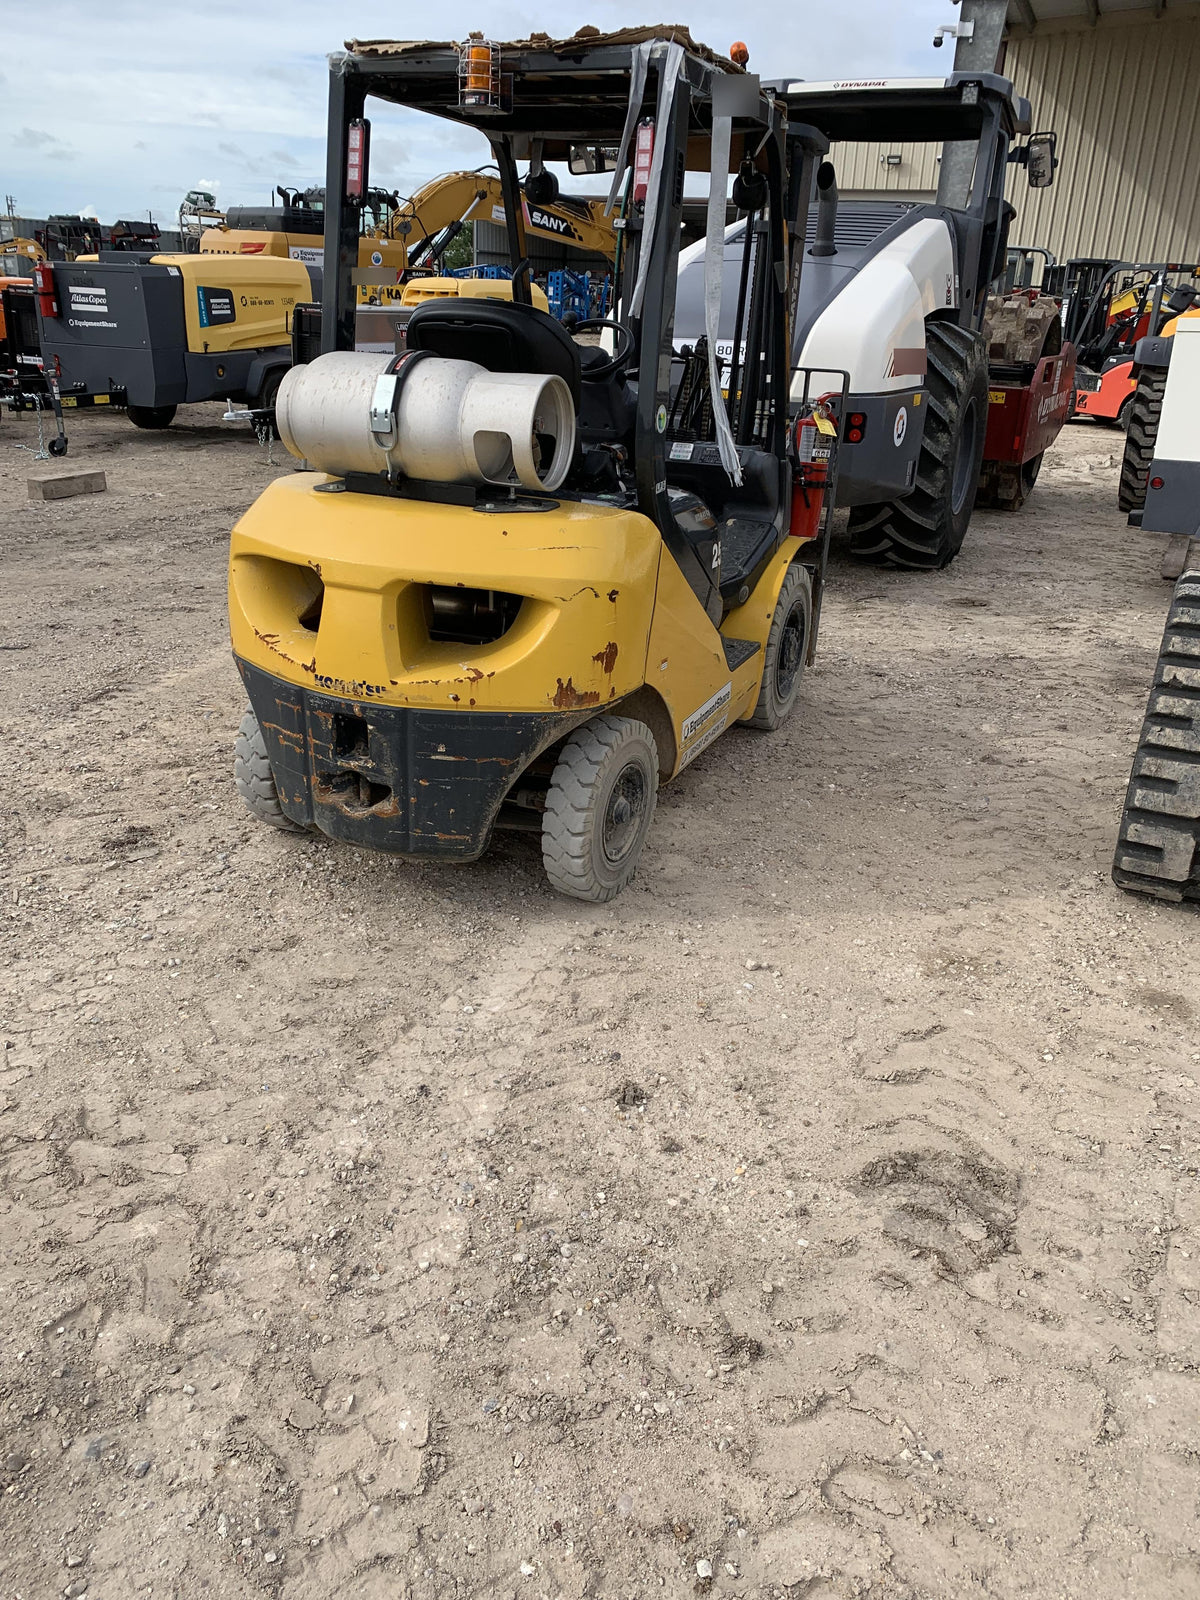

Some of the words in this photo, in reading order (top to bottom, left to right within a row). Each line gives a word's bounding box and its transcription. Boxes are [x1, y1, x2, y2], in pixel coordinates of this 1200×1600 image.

[532, 211, 568, 232] SANY
[71, 293, 89, 303] Atlas
[89, 295, 107, 305] Copco
[75, 319, 118, 328] EquipmentShare
[689, 690, 731, 733] EquipmentShare
